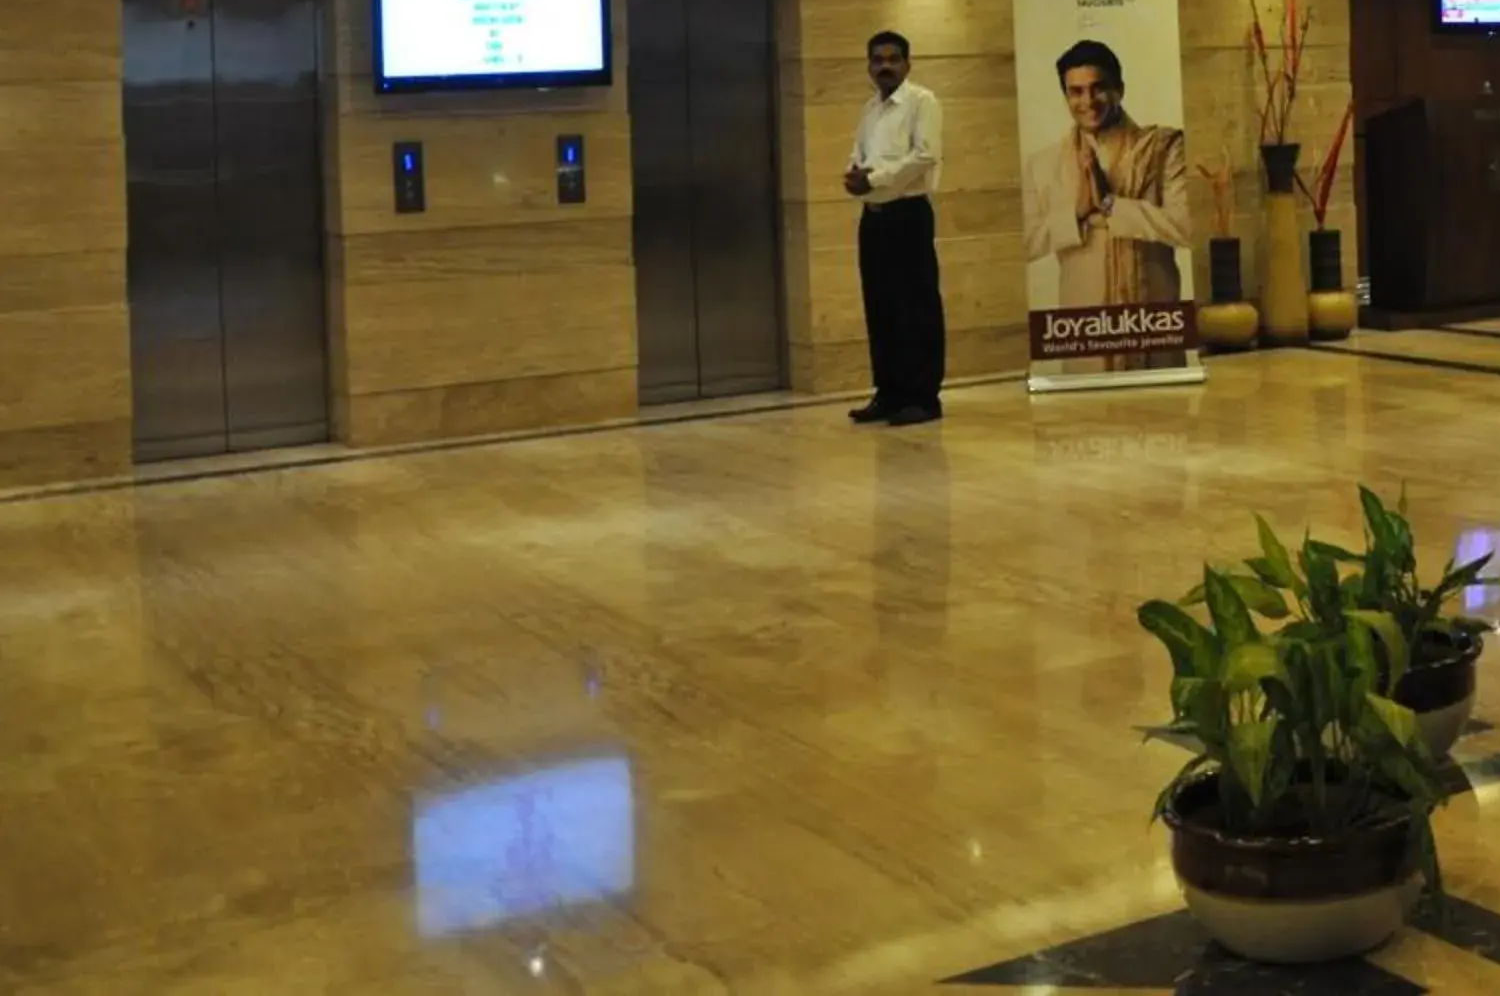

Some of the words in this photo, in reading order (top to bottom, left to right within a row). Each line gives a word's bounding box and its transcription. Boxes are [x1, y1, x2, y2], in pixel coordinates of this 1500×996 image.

[1043, 307, 1185, 340] Joyalukkas
[1043, 341, 1085, 353] World's
[1088, 338, 1138, 350] favourite
